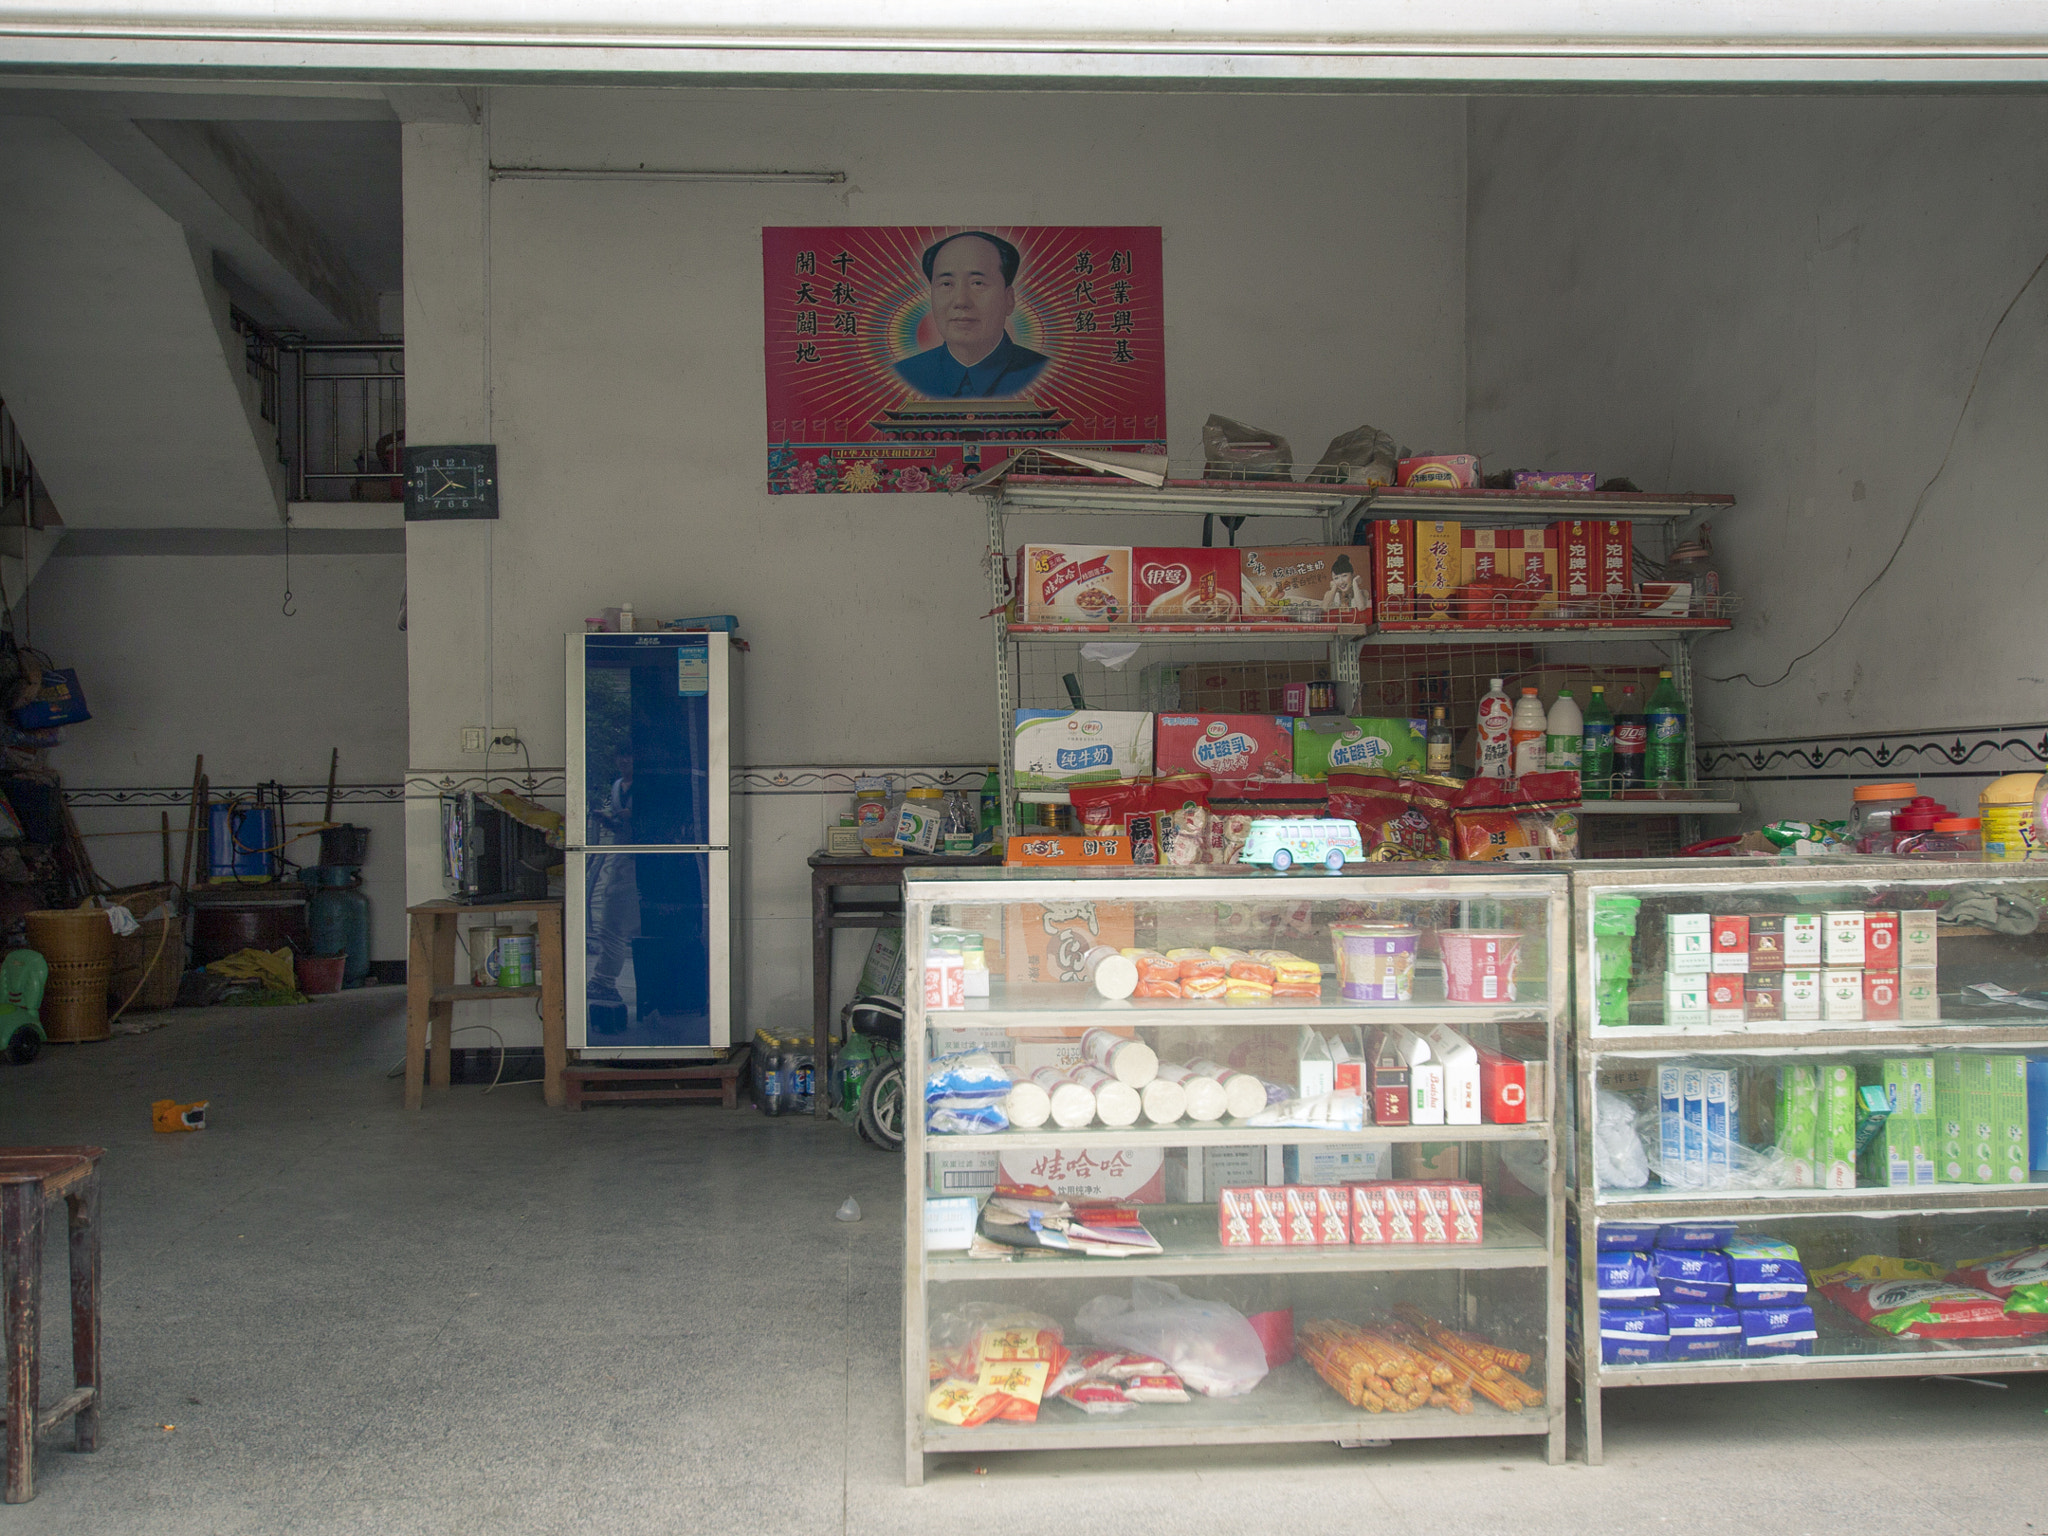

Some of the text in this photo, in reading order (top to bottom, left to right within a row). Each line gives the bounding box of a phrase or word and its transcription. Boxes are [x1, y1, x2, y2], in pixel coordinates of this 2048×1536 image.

[831, 250, 860, 337] 千秋頌
[1073, 250, 1098, 335] 萬代銘
[794, 250, 822, 365] 開天闢地
[1109, 250, 1136, 365] 創業興基
[432, 458, 440, 467] 11
[446, 458, 455, 467] 12
[462, 458, 467, 467] 1
[415, 465, 425, 474] 10
[477, 464, 485, 473] 2
[416, 480, 424, 488] 9
[477, 479, 485, 487] 3
[417, 494, 425, 503] 8
[478, 493, 485, 502] 4
[434, 500, 440, 508] 7
[448, 500, 455, 508] 6
[462, 500, 469, 508] 5
[1035, 559, 1050, 574] 45
[1044, 568, 1076, 596] 娃哈哈
[1147, 569, 1182, 585] 银鹭
[1197, 735, 1250, 762] 优酸乳
[1333, 739, 1383, 766] 优酸乳
[1061, 747, 1110, 767] 纯牛奶
[1429, 1072, 1441, 1109] Baisha
[1031, 1148, 1133, 1180] 娃哈哈
[1057, 1185, 1102, 1196] 饮用纯净水
